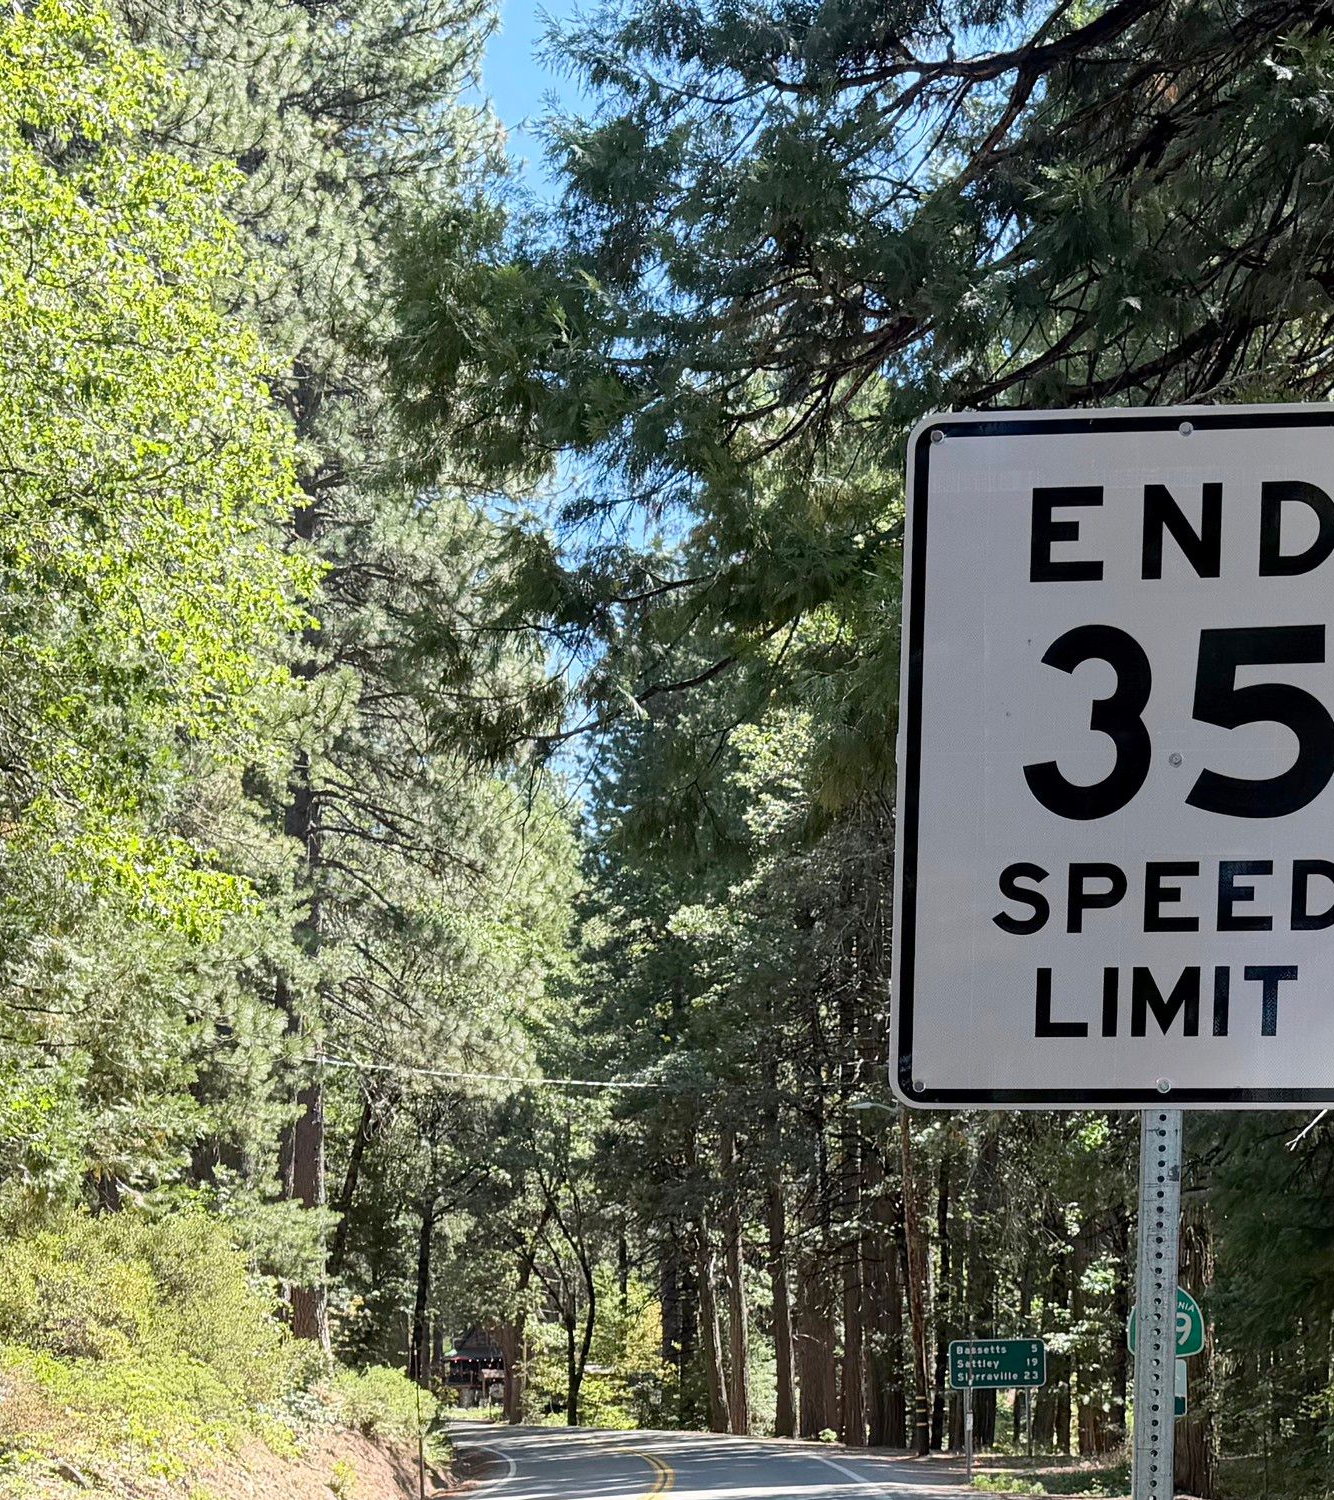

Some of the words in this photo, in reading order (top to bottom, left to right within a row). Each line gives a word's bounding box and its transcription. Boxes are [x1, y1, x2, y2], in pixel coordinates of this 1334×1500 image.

[1035, 966, 1299, 1038] LIMIT
[1175, 1312, 1192, 1346] 9
[956, 1345, 1007, 1355] Bassetts
[1031, 1344, 1038, 1353] 5
[957, 1359, 1000, 1369] Sattley
[1027, 1358, 1038, 1367] 19
[1023, 1371, 1039, 1380] 23
